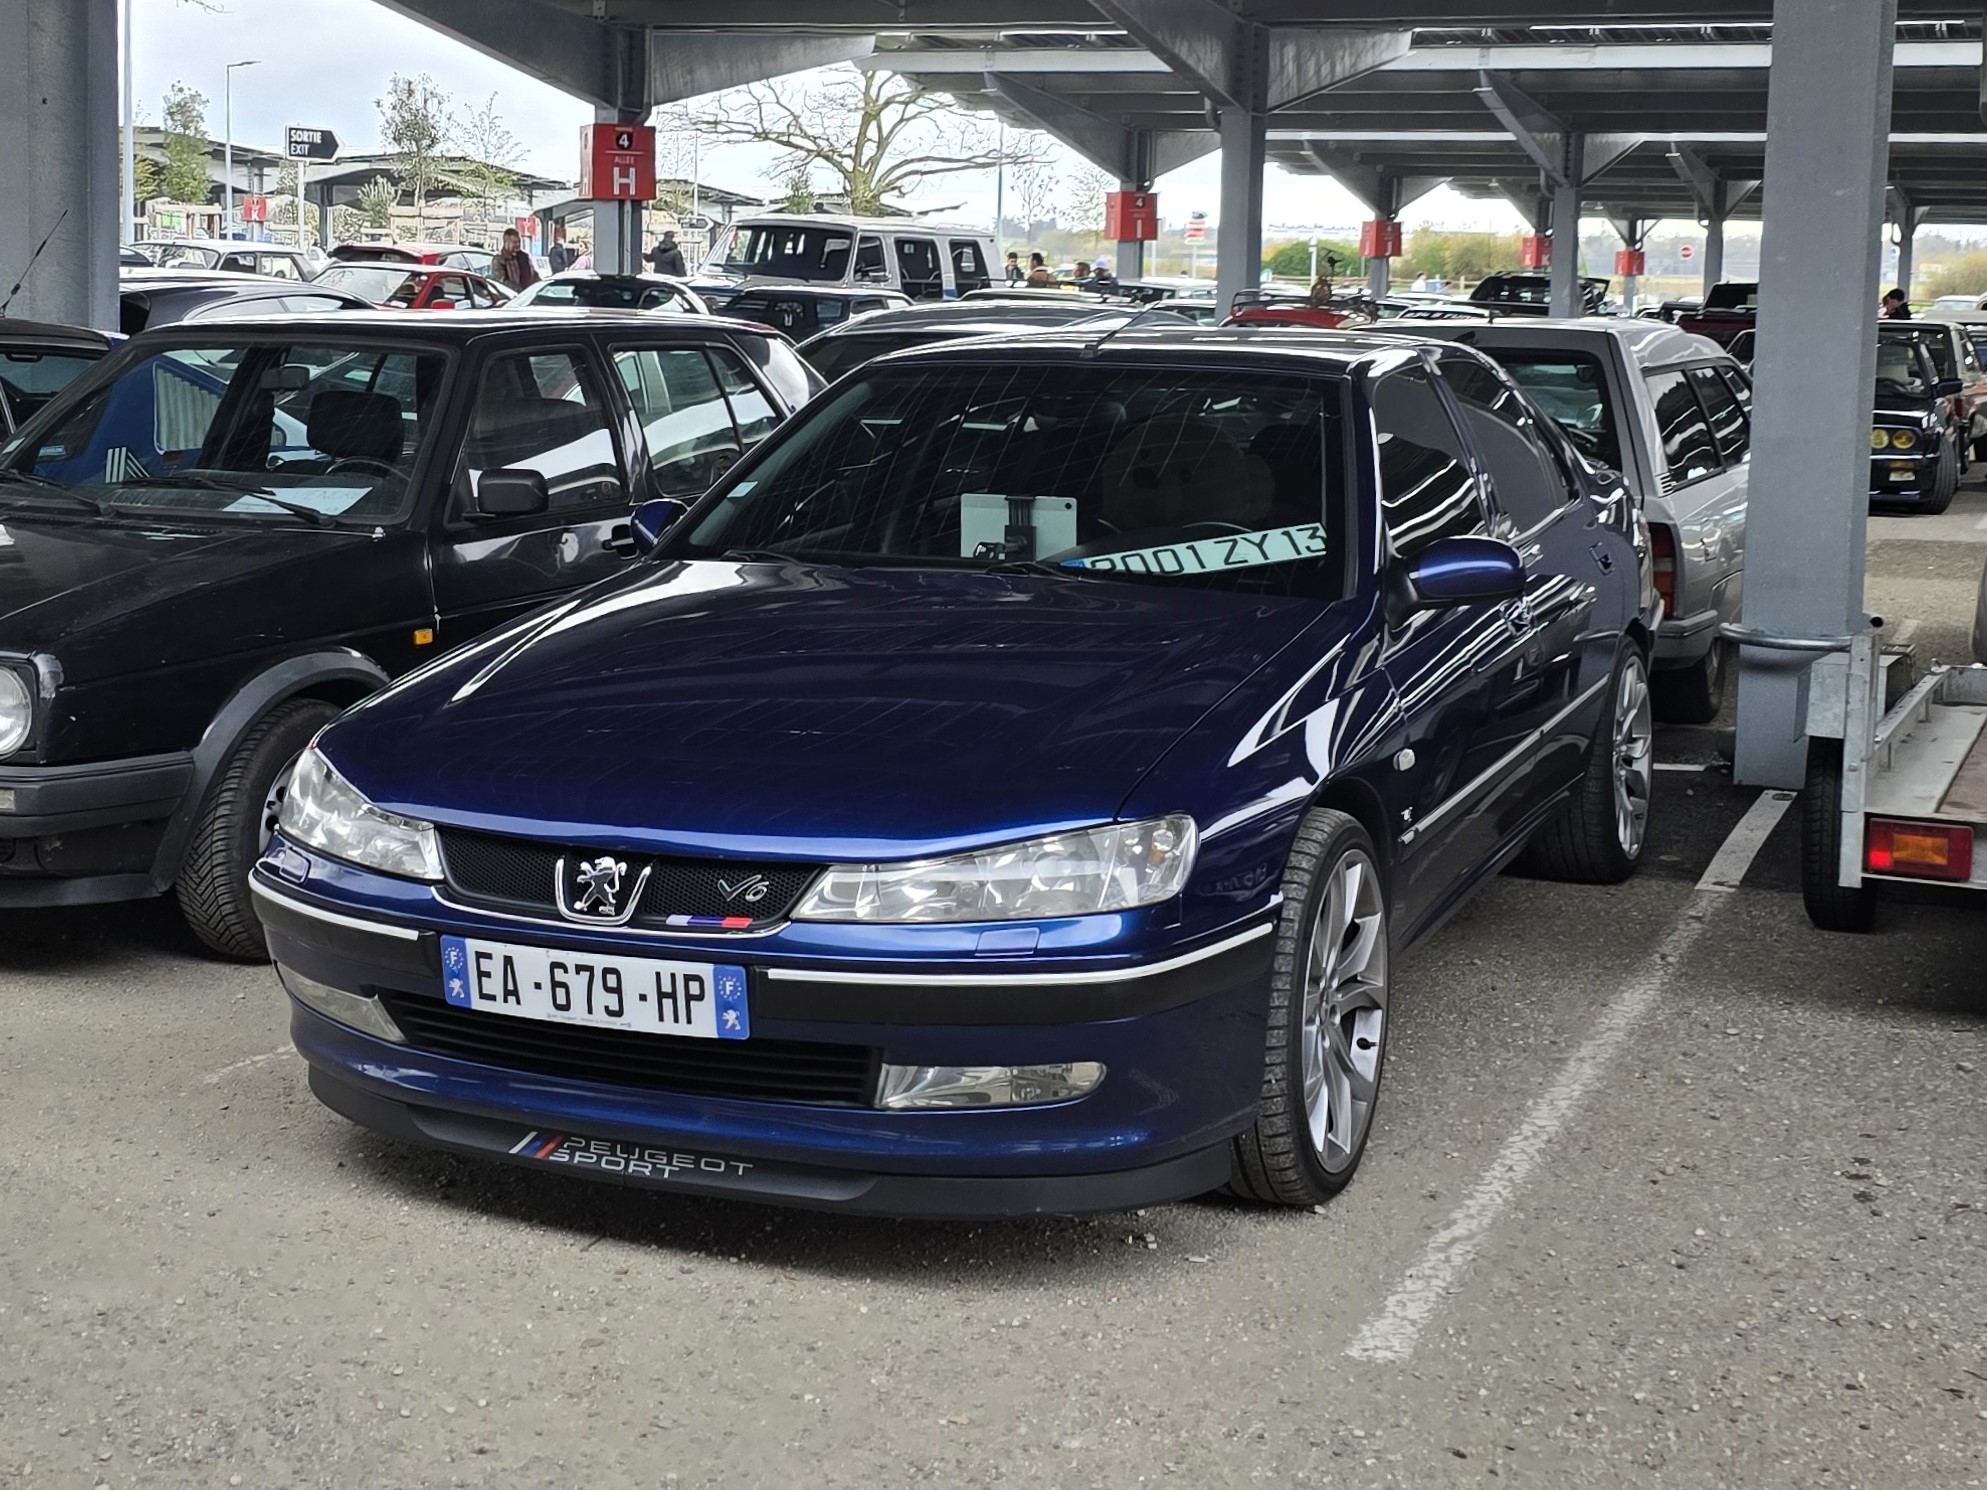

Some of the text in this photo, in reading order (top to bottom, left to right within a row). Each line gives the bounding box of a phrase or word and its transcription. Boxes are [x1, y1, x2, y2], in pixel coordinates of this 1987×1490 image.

[290, 130, 322, 144] SORTIE
[619, 133, 630, 148] 4
[290, 143, 310, 156] EXIT
[613, 166, 636, 196] H
[1135, 198, 1144, 208] 4
[1385, 240, 1393, 256] J
[1541, 253, 1551, 266] K
[1213, 533, 1270, 566] ZY
[1281, 526, 1327, 556] 13
[717, 874, 770, 902] V6
[725, 981, 735, 996] F
[548, 1149, 681, 1178] SPORT
[563, 1136, 754, 1176] PEUGEOT
